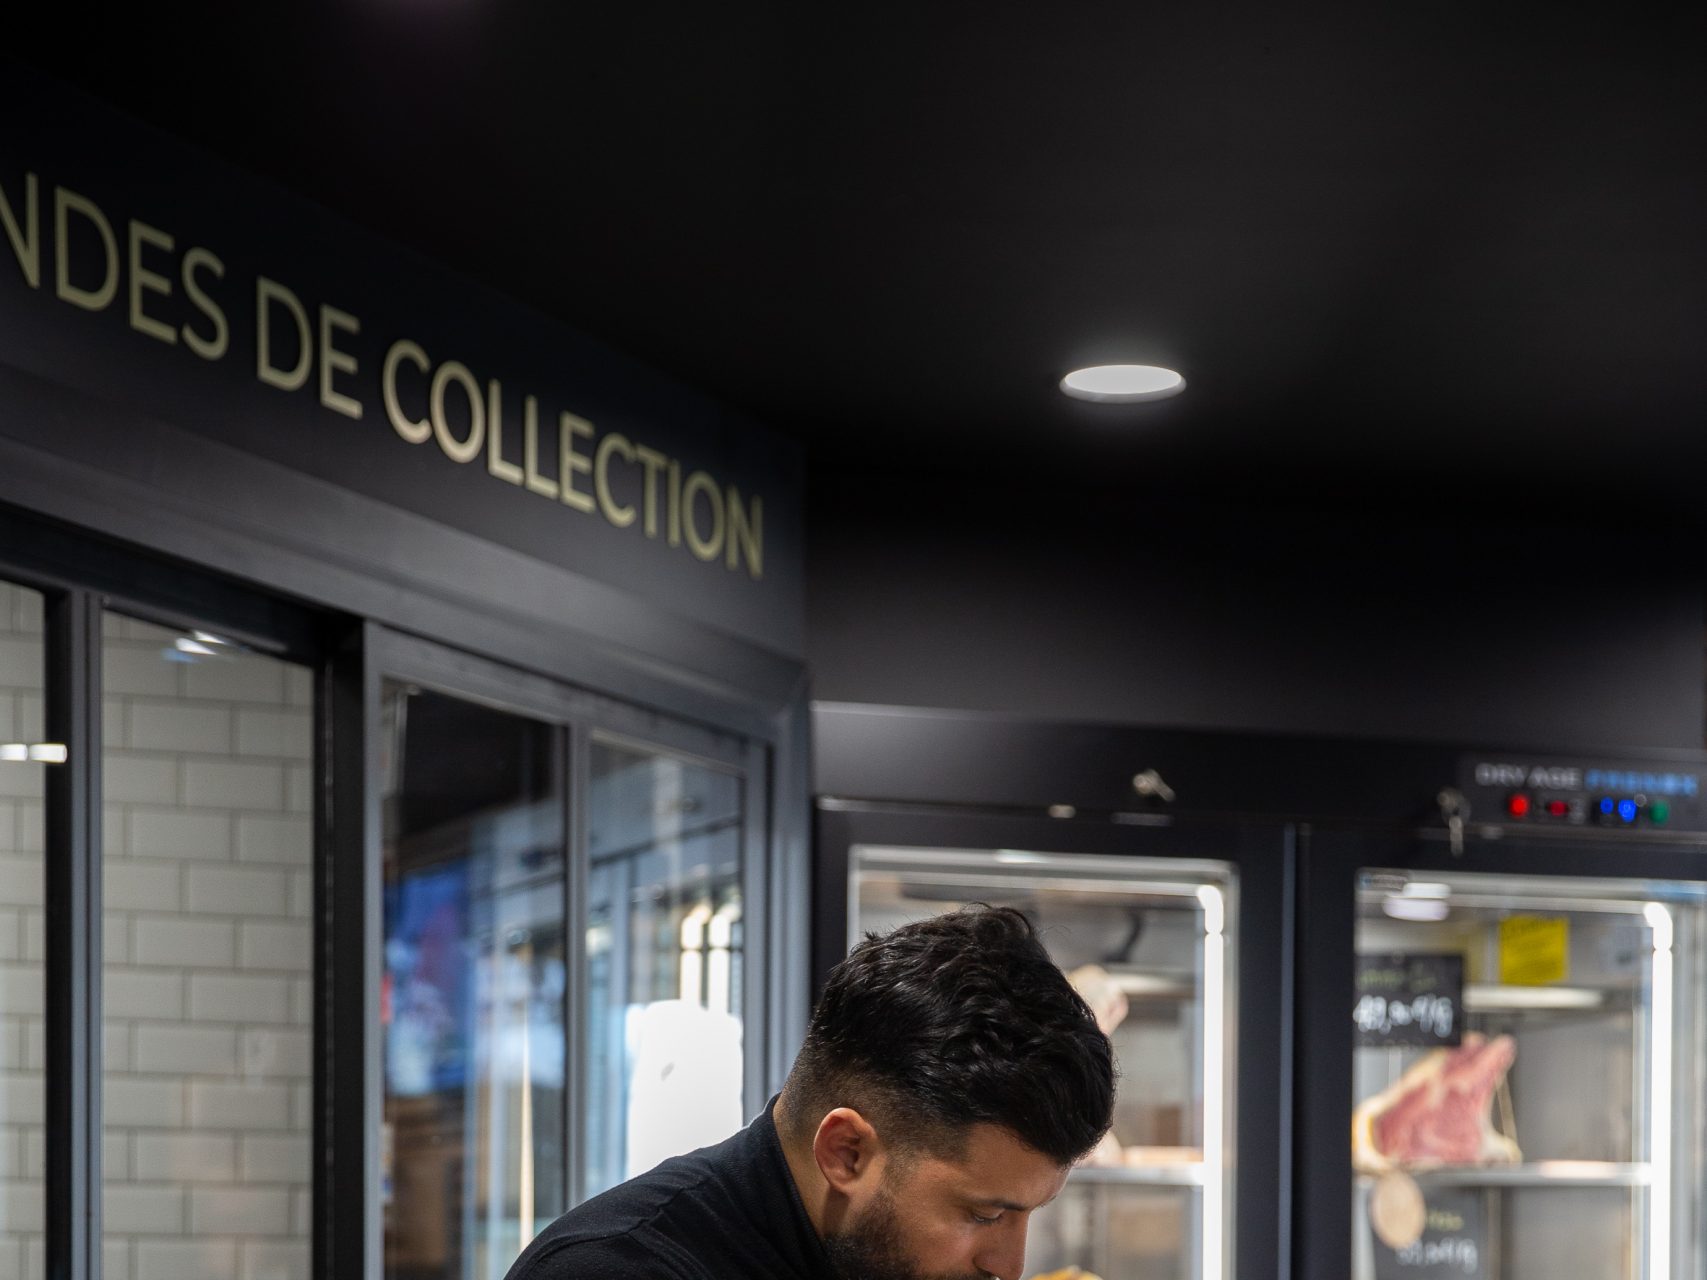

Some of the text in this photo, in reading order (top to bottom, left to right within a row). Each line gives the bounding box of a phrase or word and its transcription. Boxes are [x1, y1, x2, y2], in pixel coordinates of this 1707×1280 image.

[0, 172, 763, 580] NDES DE COLLECTION
